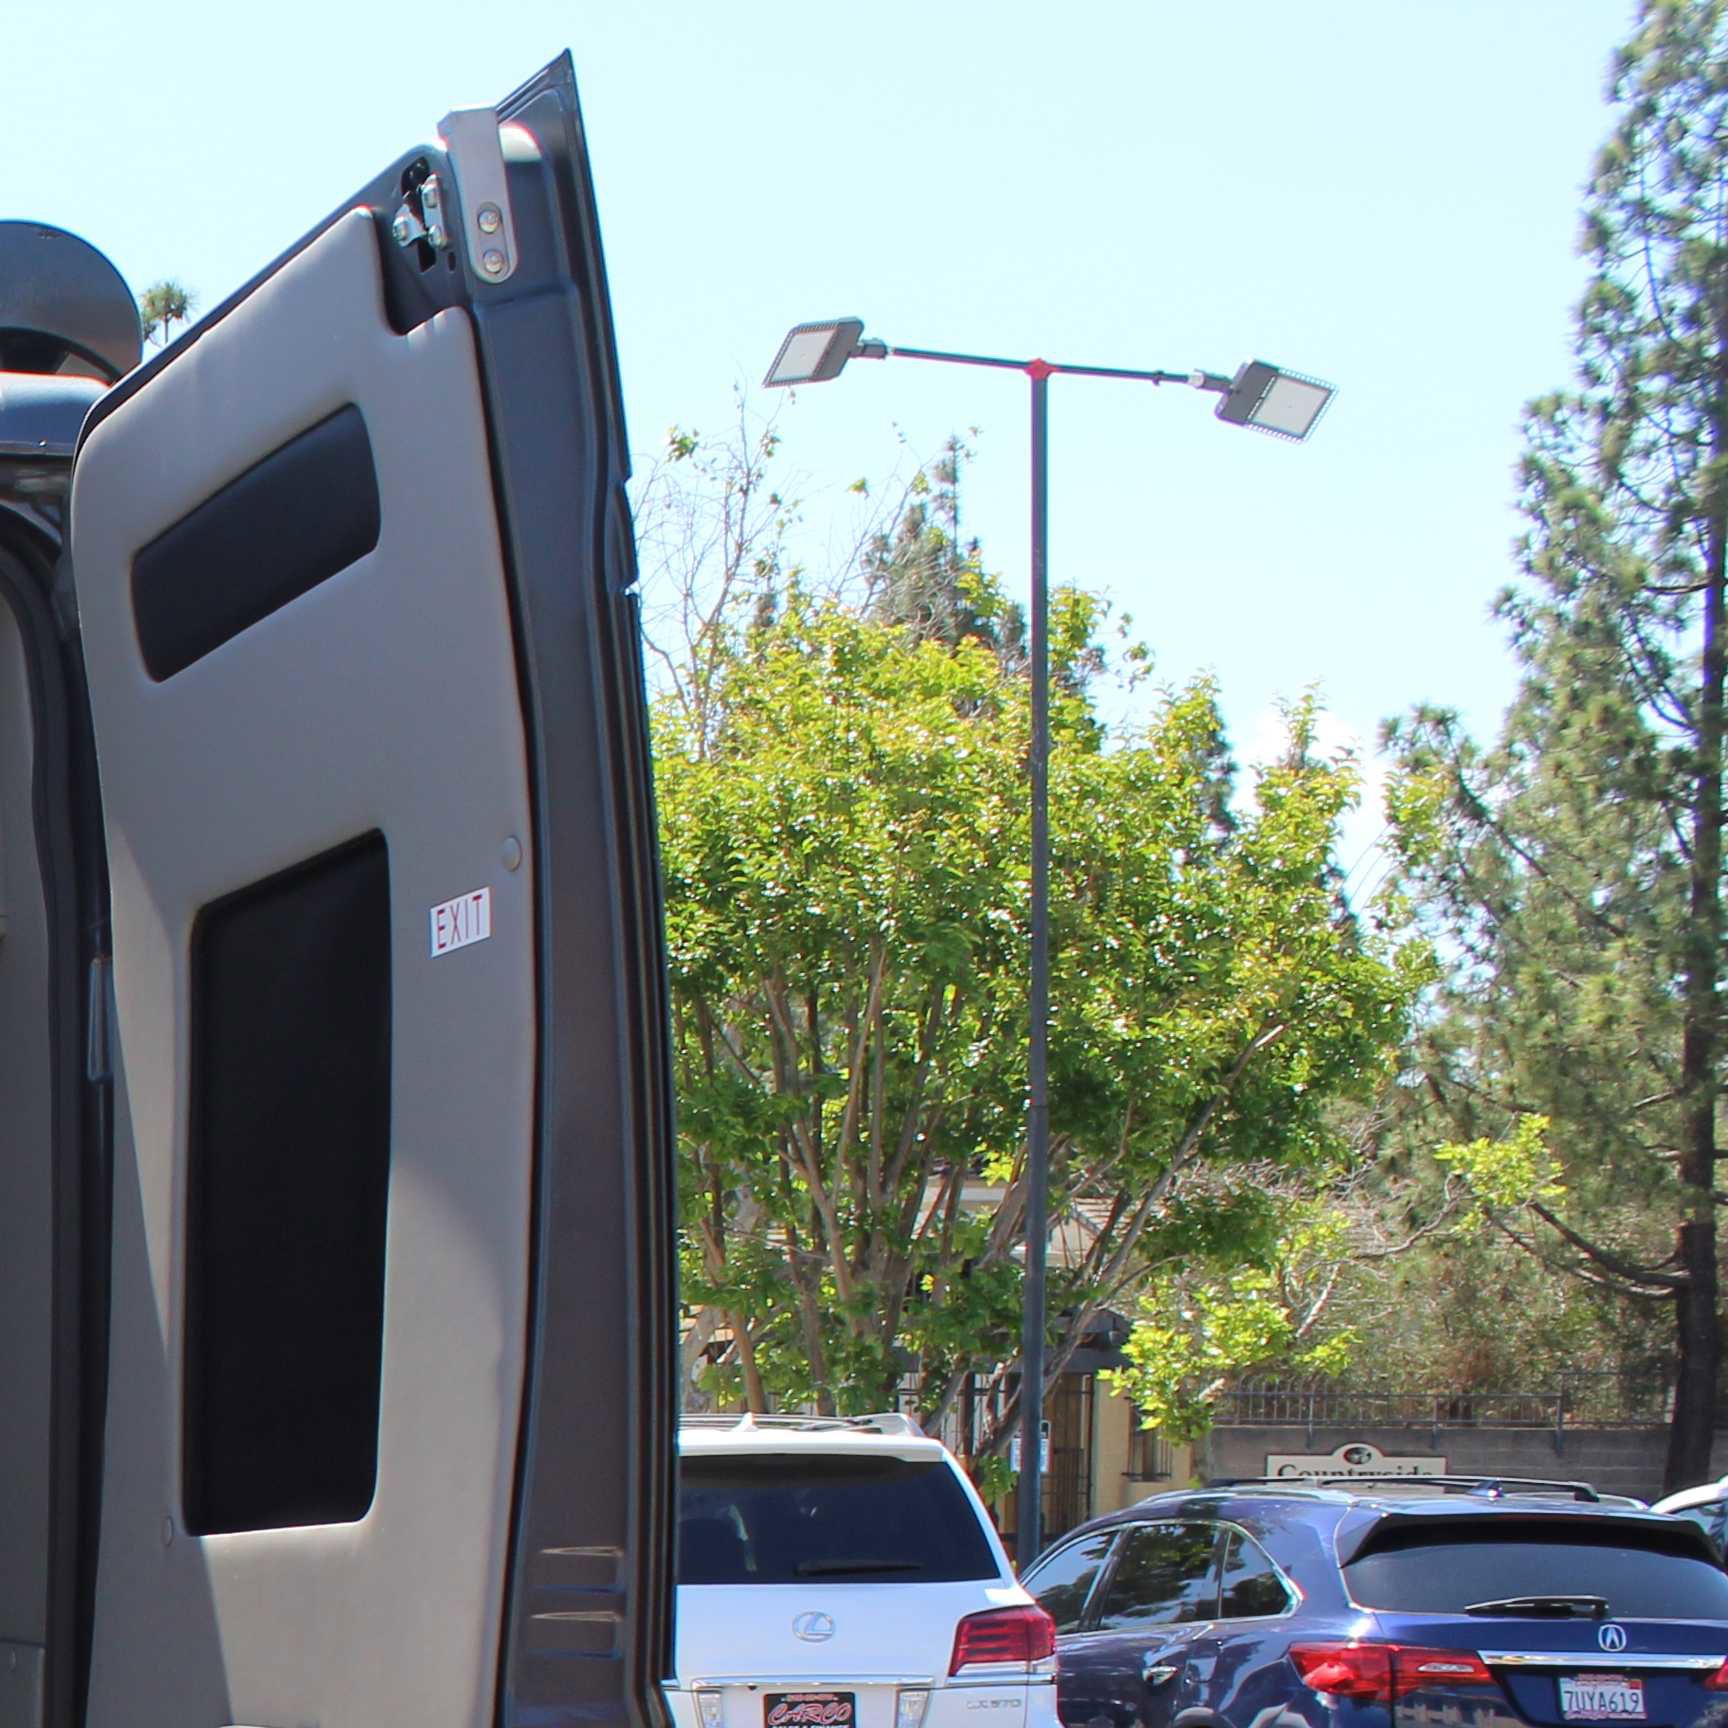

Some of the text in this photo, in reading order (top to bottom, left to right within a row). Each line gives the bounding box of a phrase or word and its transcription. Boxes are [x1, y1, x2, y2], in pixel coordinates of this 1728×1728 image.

[436, 894, 483, 950] EXIT
[1564, 1690, 1640, 1713] 7UYA619
[768, 1702, 852, 1726] CARCO
